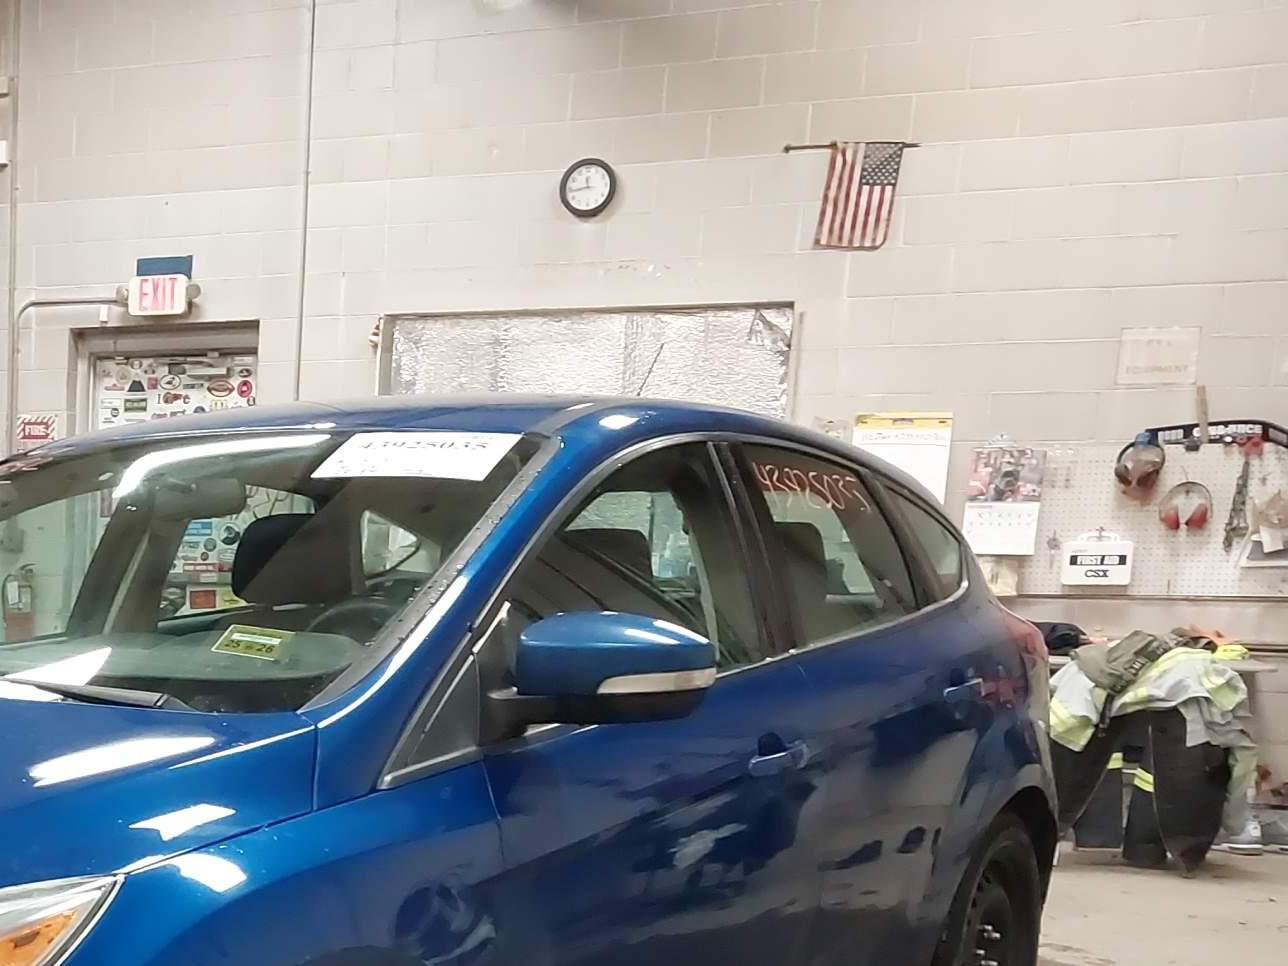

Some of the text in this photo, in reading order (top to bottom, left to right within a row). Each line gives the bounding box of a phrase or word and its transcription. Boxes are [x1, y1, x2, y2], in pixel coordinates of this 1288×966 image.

[138, 276, 178, 312] EXIT
[24, 424, 48, 436] FIRE
[1084, 569, 1110, 577] CSX
